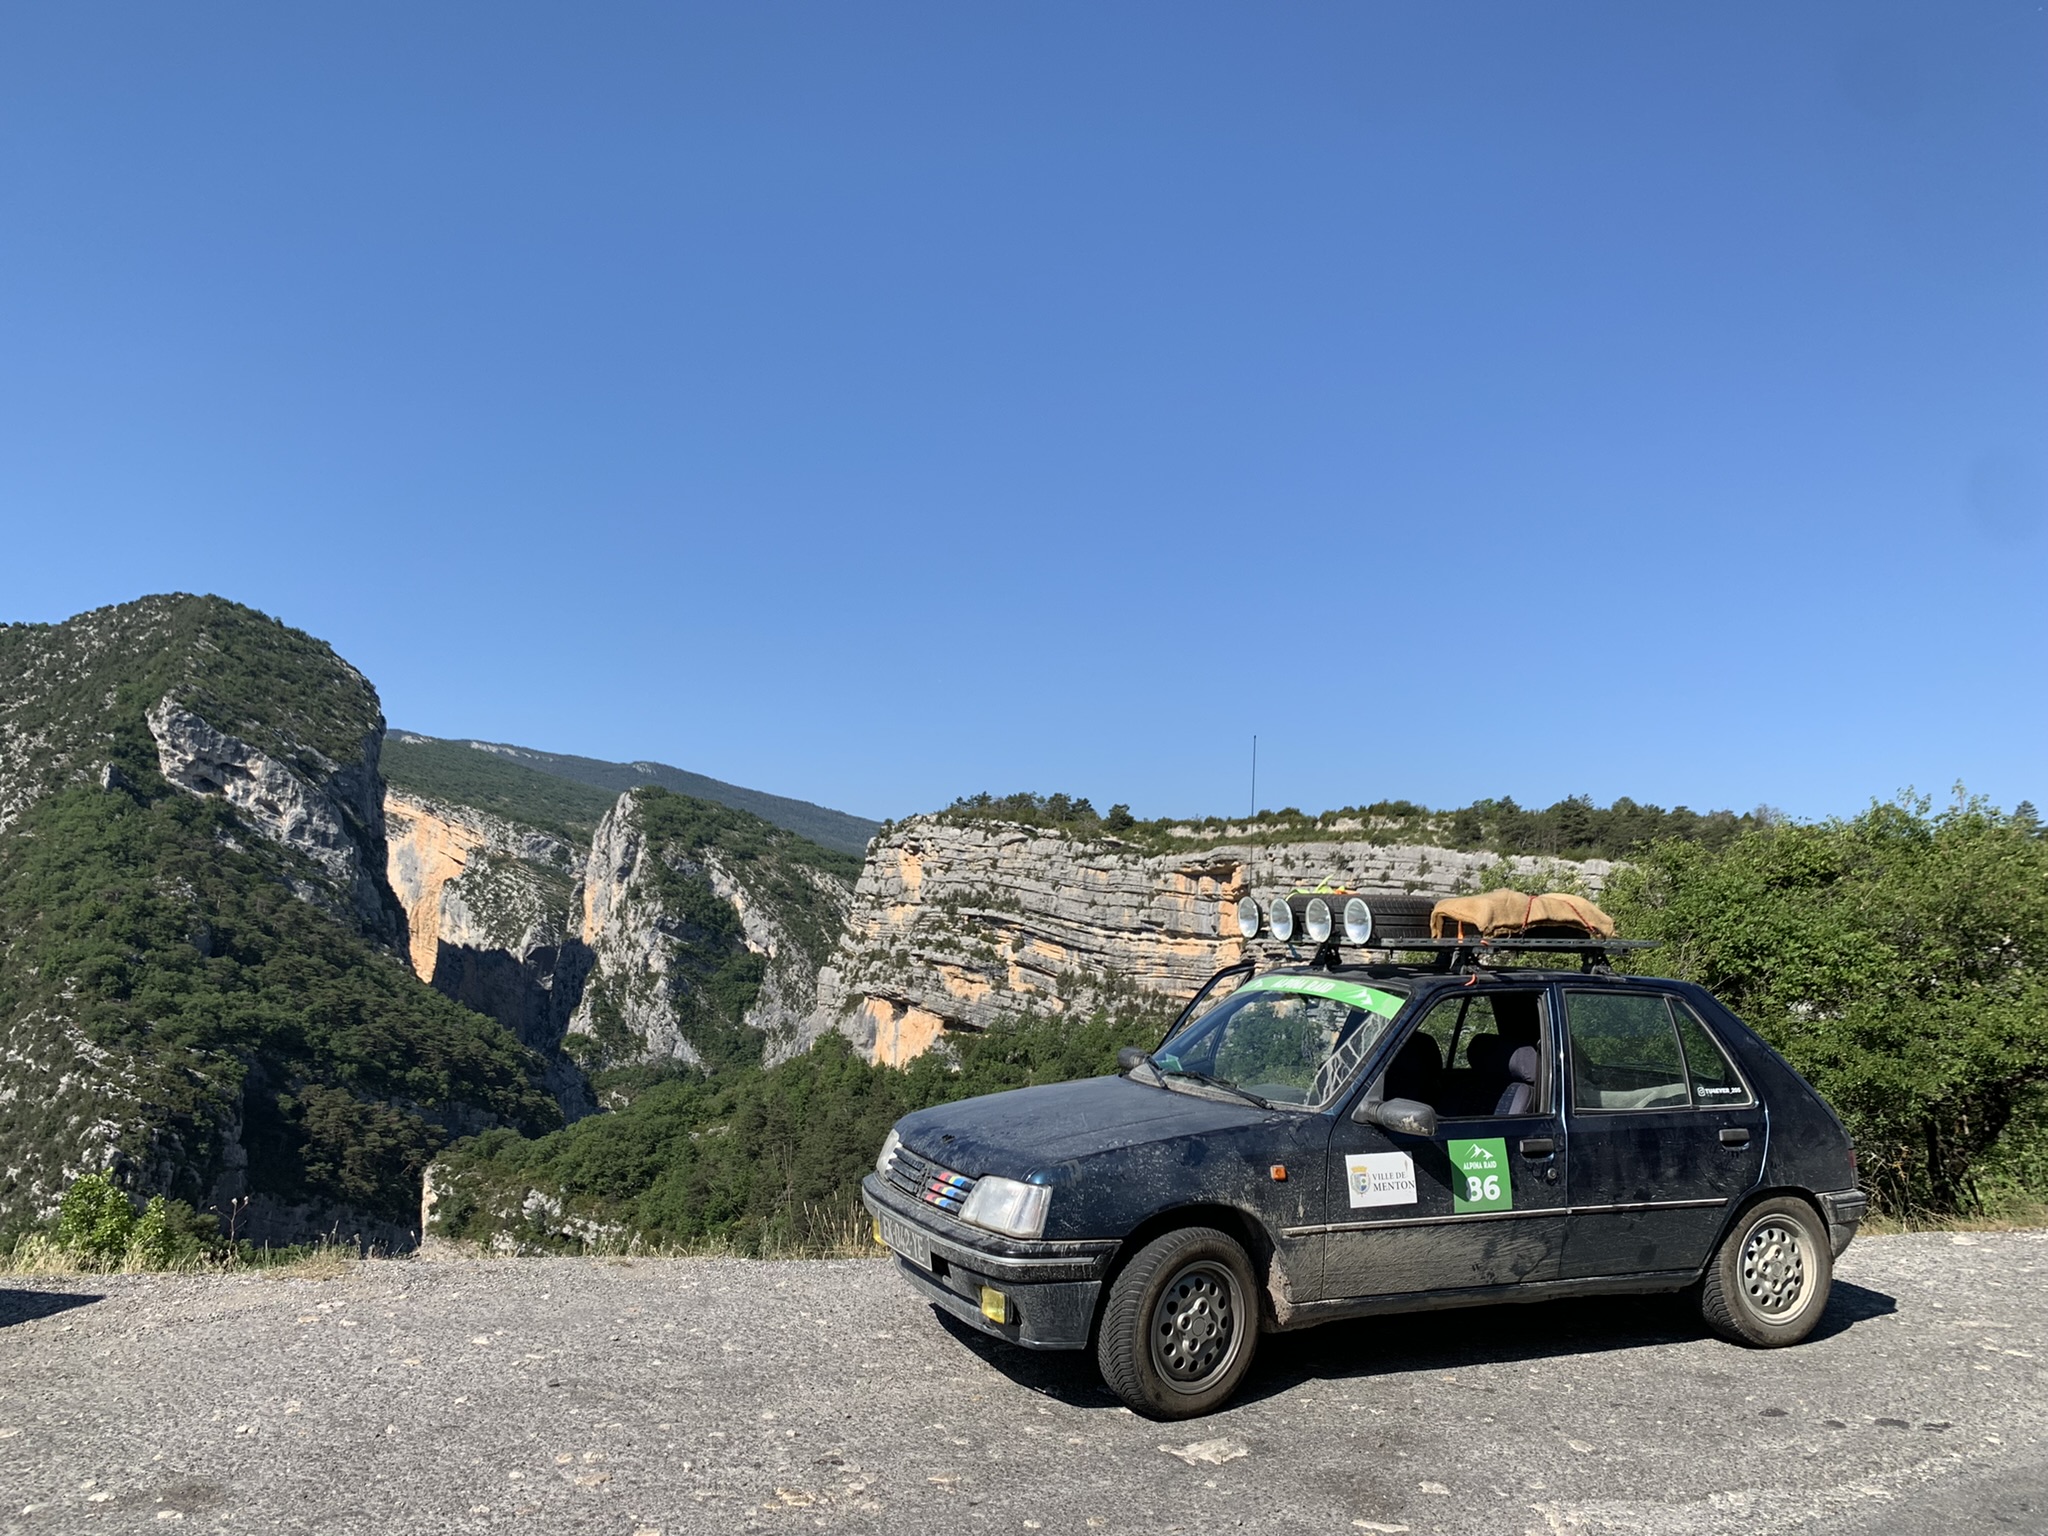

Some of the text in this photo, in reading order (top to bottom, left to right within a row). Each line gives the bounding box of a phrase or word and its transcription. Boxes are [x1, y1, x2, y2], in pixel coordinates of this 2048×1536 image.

[1271, 978, 1336, 993] ALPINA RAID
[1463, 1160, 1497, 1170] ALPINA RAID
[1372, 1171, 1407, 1181] VILLE DE
[1373, 1180, 1415, 1191] MENTON
[1465, 1174, 1501, 1202] 86
